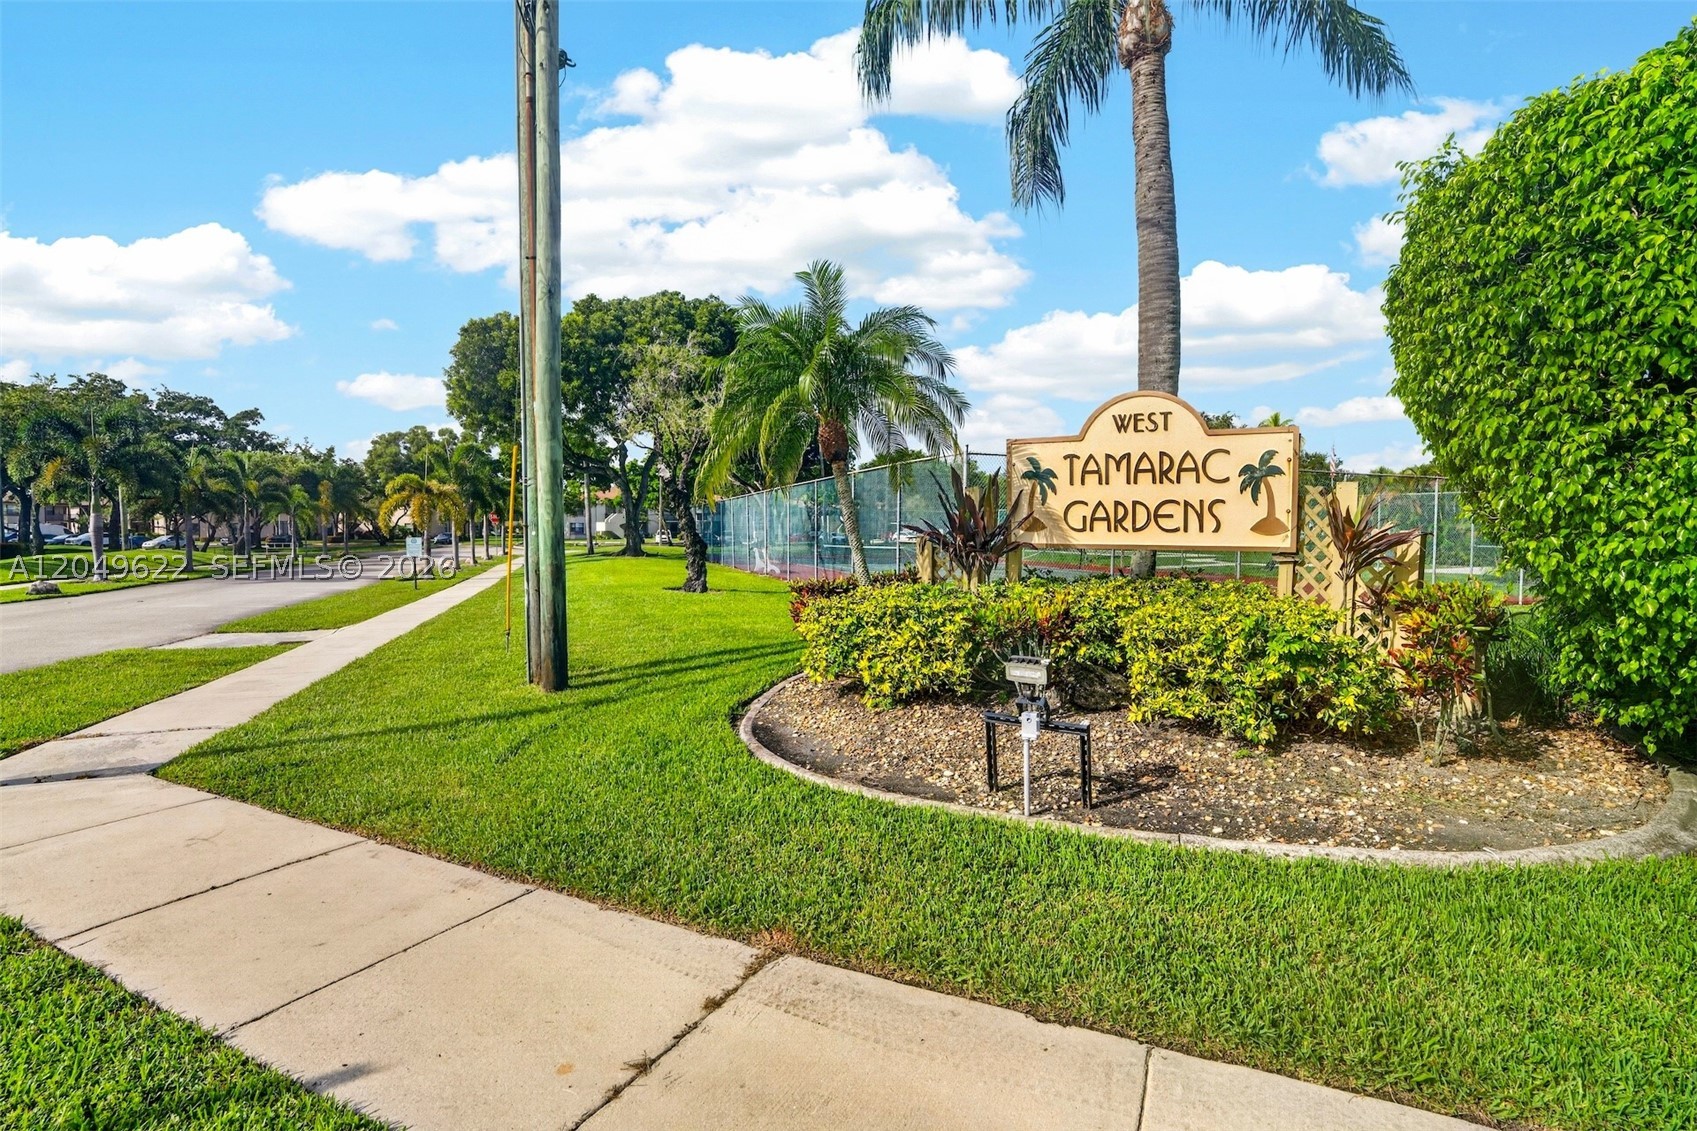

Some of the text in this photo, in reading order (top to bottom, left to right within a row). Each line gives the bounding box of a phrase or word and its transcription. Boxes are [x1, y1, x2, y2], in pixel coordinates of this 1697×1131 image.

[1112, 411, 1172, 433] WEST
[1063, 448, 1231, 486] TAMARAC
[1063, 498, 1226, 533] GARDENS
